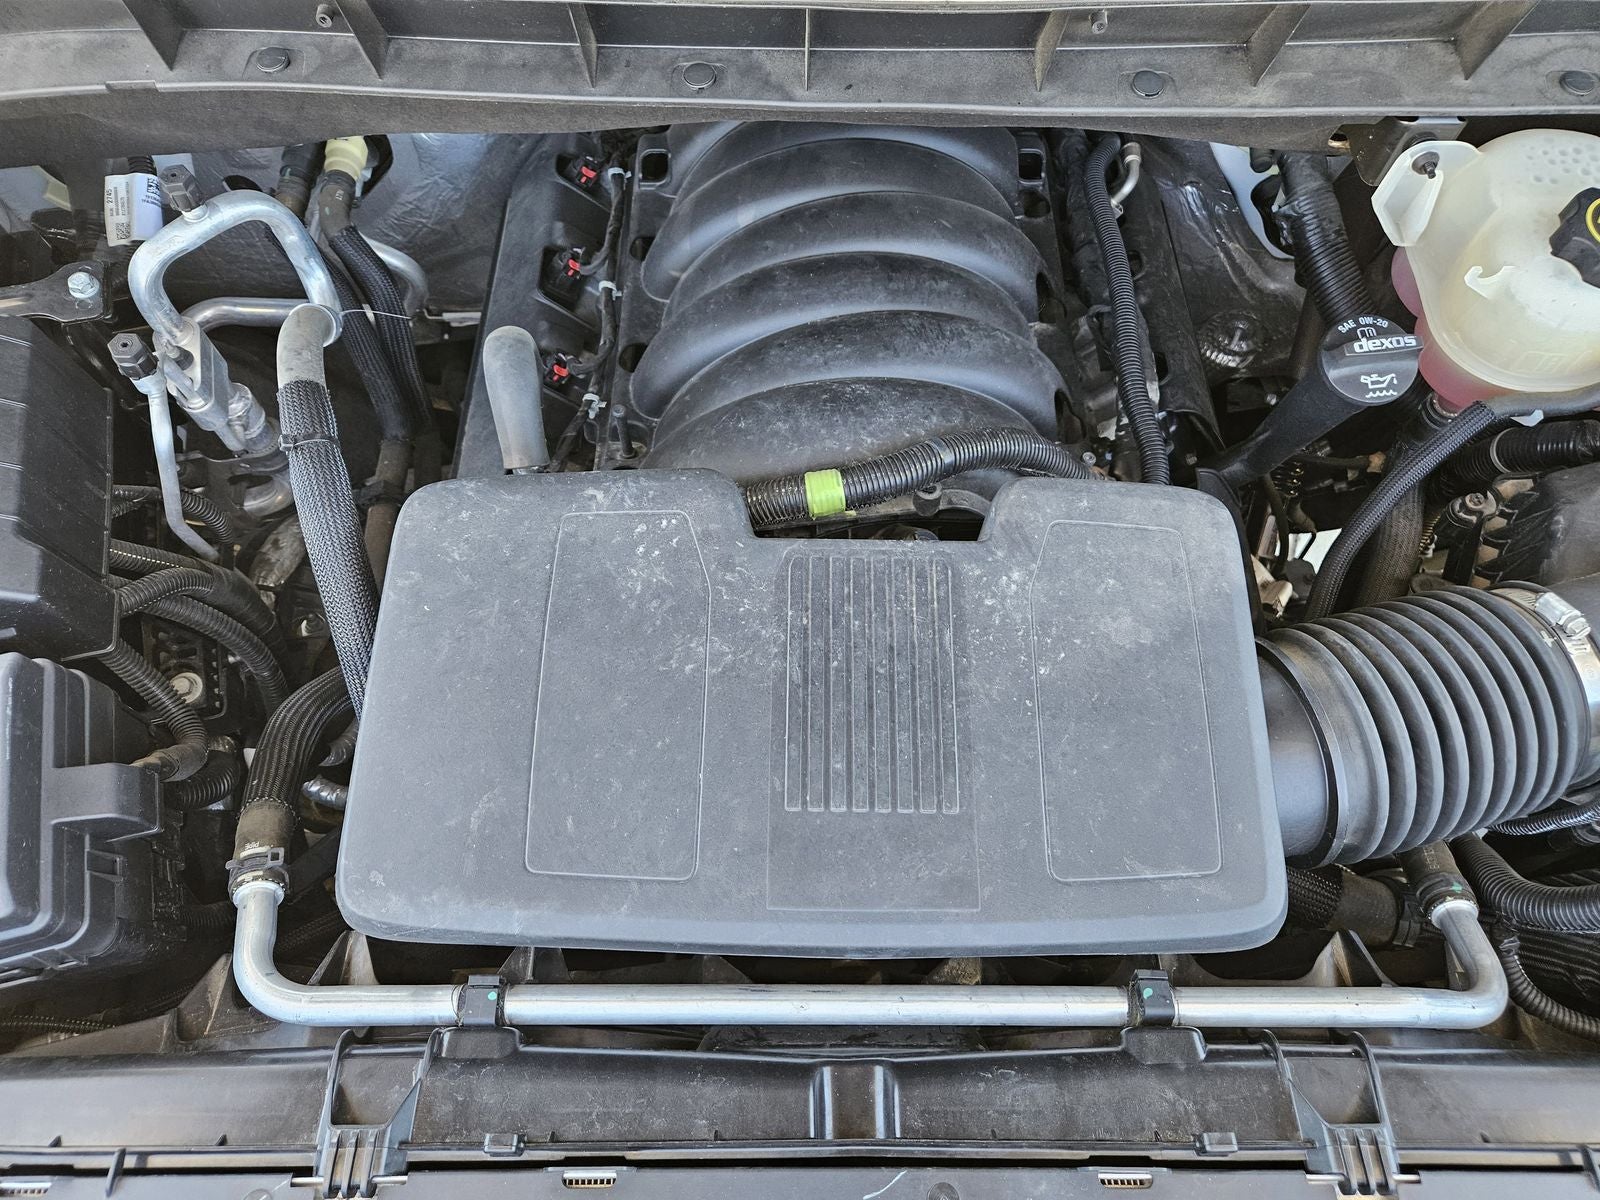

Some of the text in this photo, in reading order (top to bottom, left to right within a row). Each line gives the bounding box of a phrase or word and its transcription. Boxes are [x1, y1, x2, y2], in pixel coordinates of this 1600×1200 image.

[1337, 316, 1389, 334] SAE 0W-20
[1353, 335, 1417, 353] dexos
